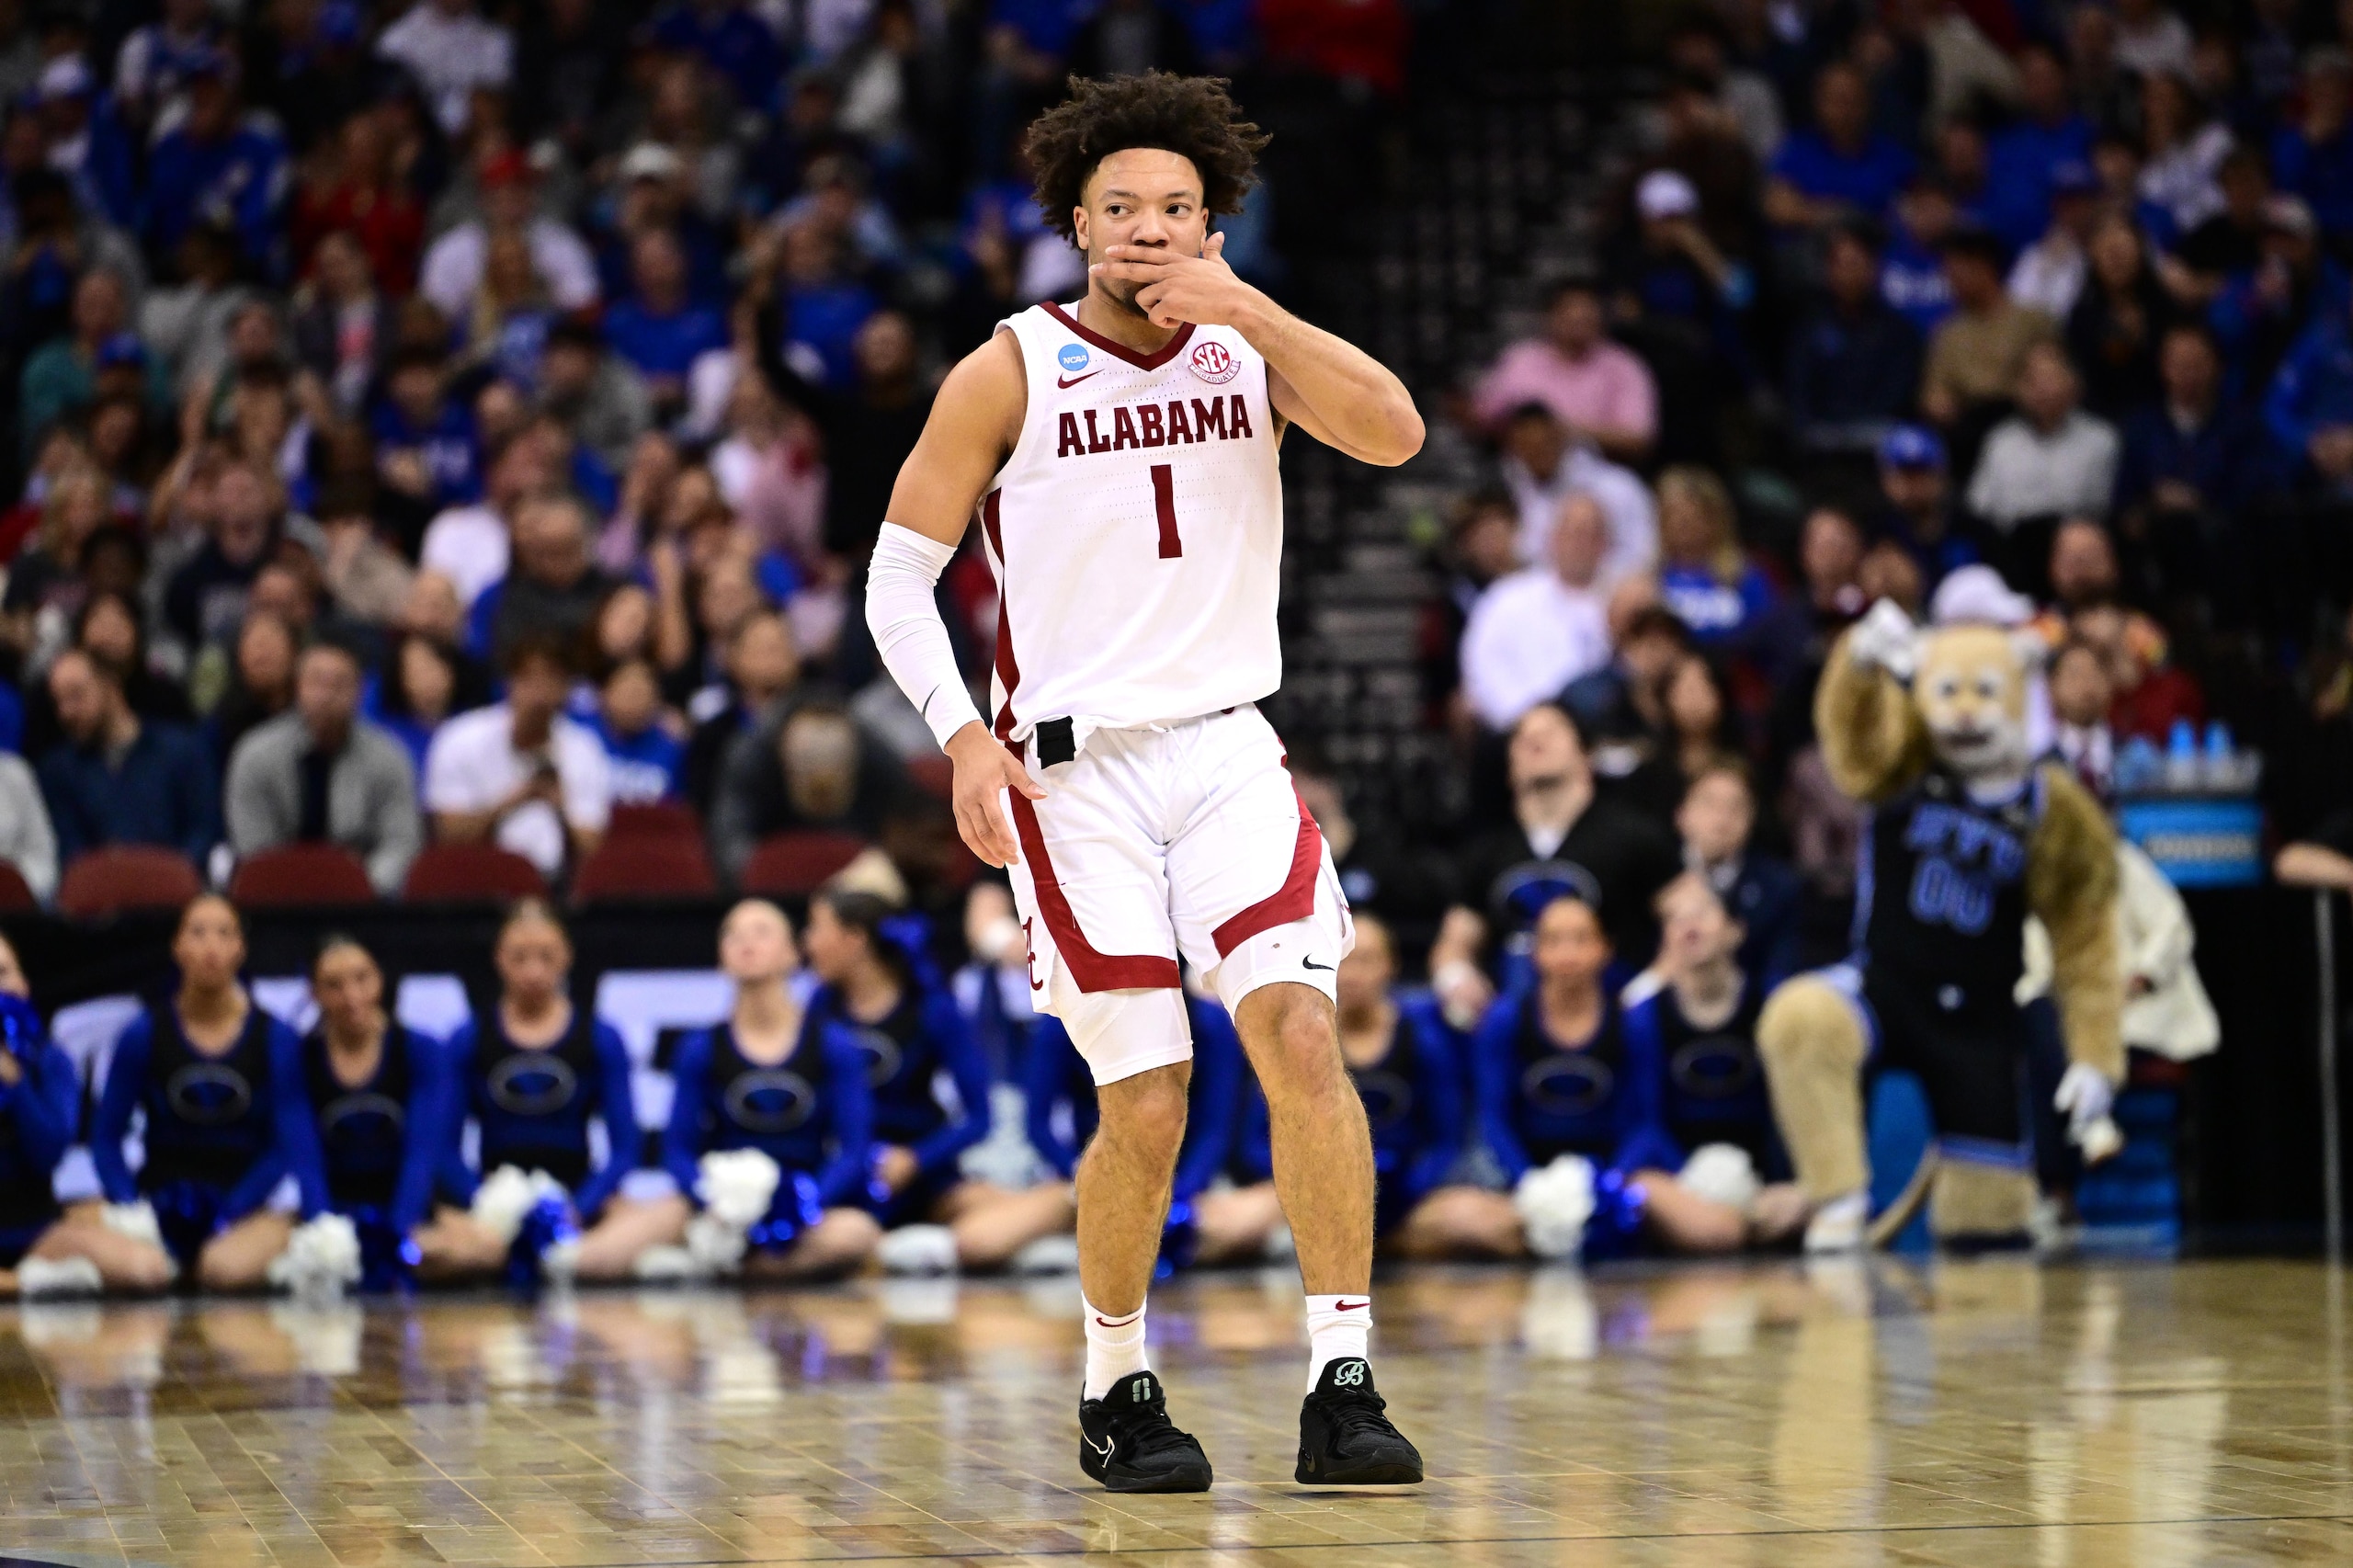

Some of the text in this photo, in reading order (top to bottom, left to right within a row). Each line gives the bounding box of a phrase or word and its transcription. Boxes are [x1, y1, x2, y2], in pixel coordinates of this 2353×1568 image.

[1063, 355, 1088, 365] NCAA
[1194, 343, 1229, 373] SEC
[1196, 369, 1236, 382] GRADUATE
[1057, 394, 1253, 458] ALABAMA
[1150, 464, 1183, 559] 1
